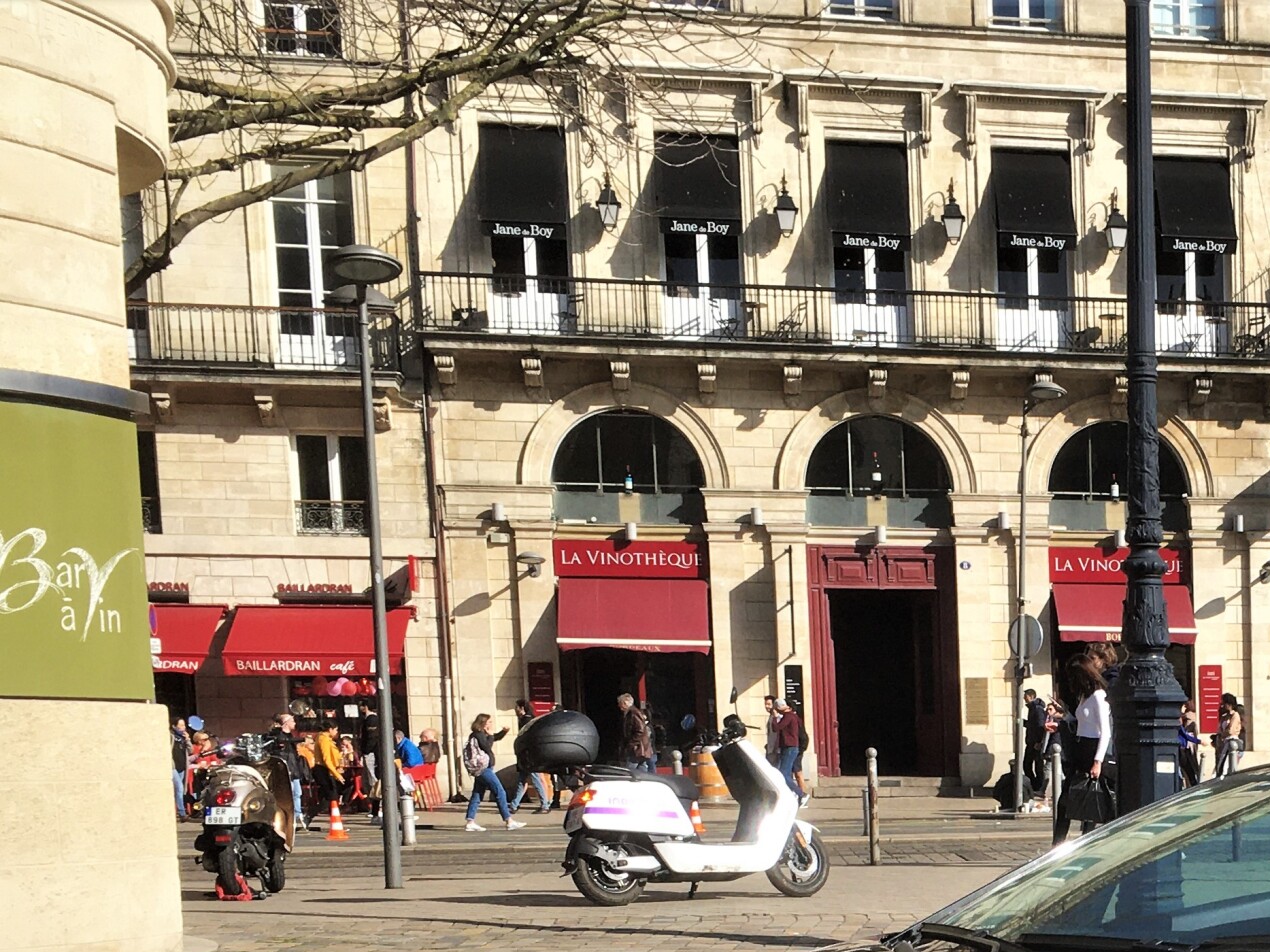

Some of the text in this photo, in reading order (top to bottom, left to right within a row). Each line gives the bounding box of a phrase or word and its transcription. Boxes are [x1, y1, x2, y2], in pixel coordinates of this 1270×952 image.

[492, 222, 521, 235] Jane
[530, 224, 554, 239] Boy
[670, 220, 698, 232] Jane
[706, 221, 730, 235] Boy
[843, 234, 870, 246] Jane
[877, 235, 901, 250] Boy
[1010, 234, 1037, 247] Jane
[1044, 236, 1067, 250] Boy
[1172, 238, 1199, 251] Jane
[1205, 240, 1228, 254] Boy
[561, 549, 702, 569] LA VINOTHÈQUE
[1054, 557, 1183, 575] LA VINOUE
[277, 583, 352, 593] BAILLARDRAN
[236, 660, 355, 673] BAILLARDRAN café
